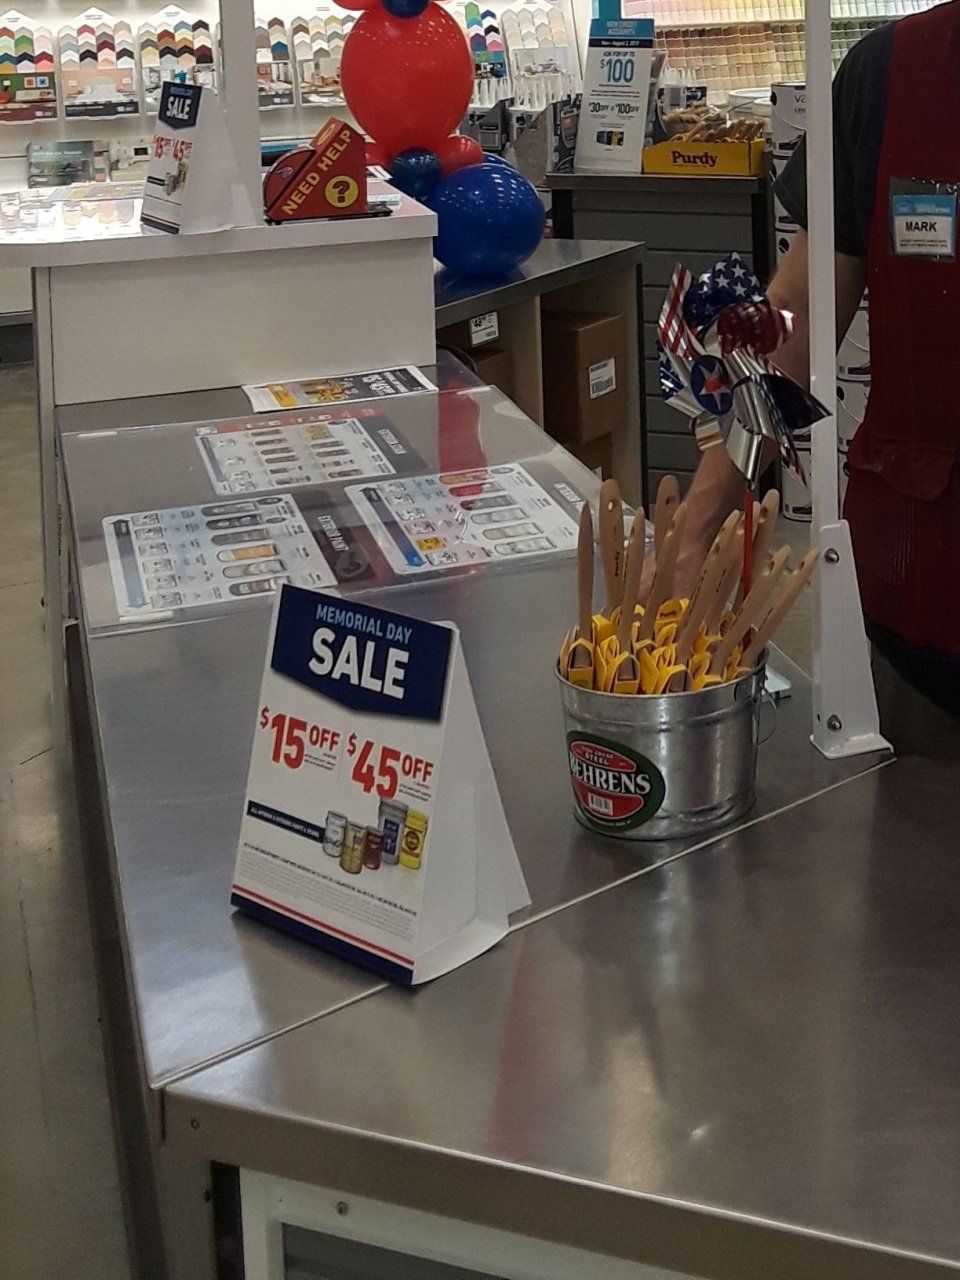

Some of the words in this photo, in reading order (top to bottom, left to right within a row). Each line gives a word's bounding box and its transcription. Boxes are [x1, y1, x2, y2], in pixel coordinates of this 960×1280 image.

[600, 58, 635, 83] $100
[166, 96, 192, 120] SALE
[281, 170, 321, 217] NEED
[316, 128, 352, 172] HELP
[672, 151, 718, 168] Purdy
[905, 221, 937, 233] MARK
[316, 604, 383, 637] MEMORIAL
[385, 624, 413, 644] DAY
[308, 627, 410, 700] SALE
[259, 706, 307, 770] $15
[308, 722, 340, 752] OFF
[347, 732, 402, 800] $45
[401, 755, 434, 783] OFF
